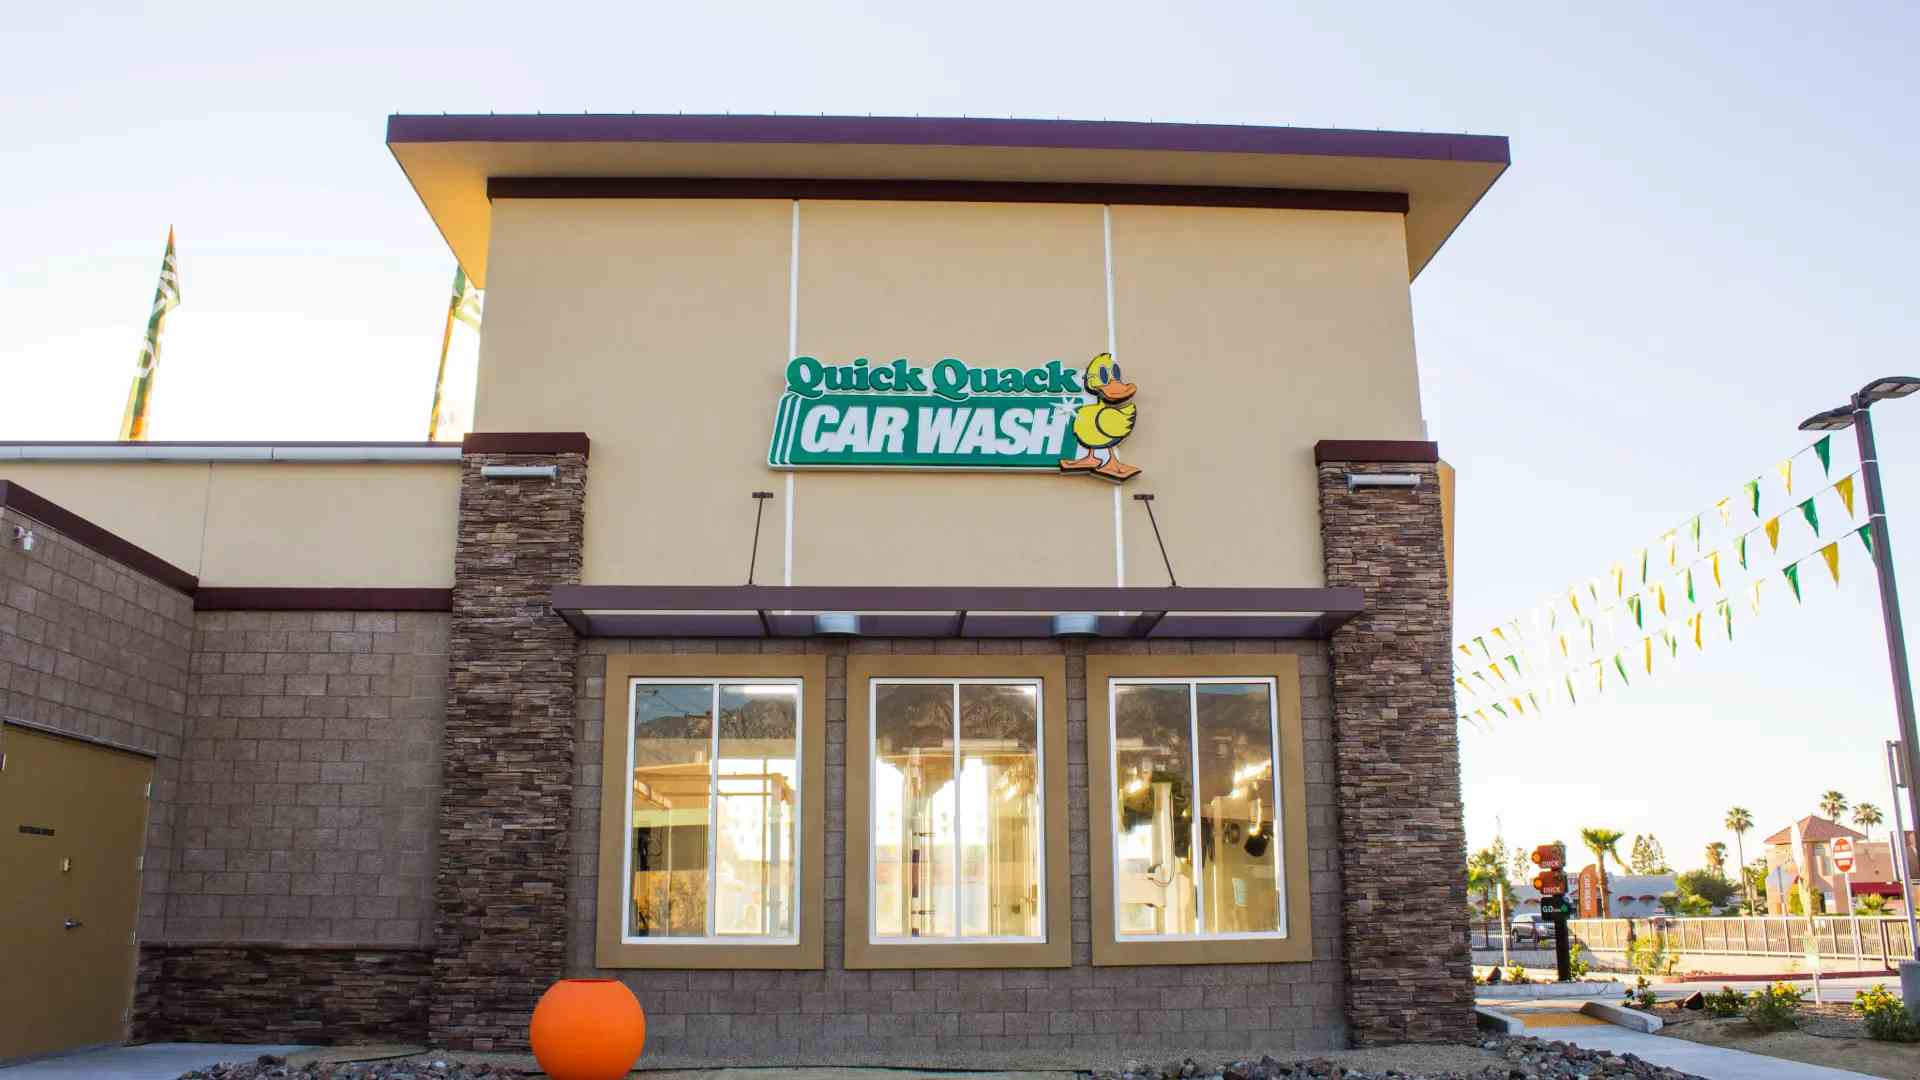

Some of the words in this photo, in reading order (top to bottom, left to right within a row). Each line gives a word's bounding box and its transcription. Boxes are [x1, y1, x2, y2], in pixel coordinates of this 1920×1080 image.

[786, 357, 927, 398] Quick
[932, 358, 1083, 400] Quack
[801, 404, 909, 453] CAR
[916, 406, 1070, 455] WASH
